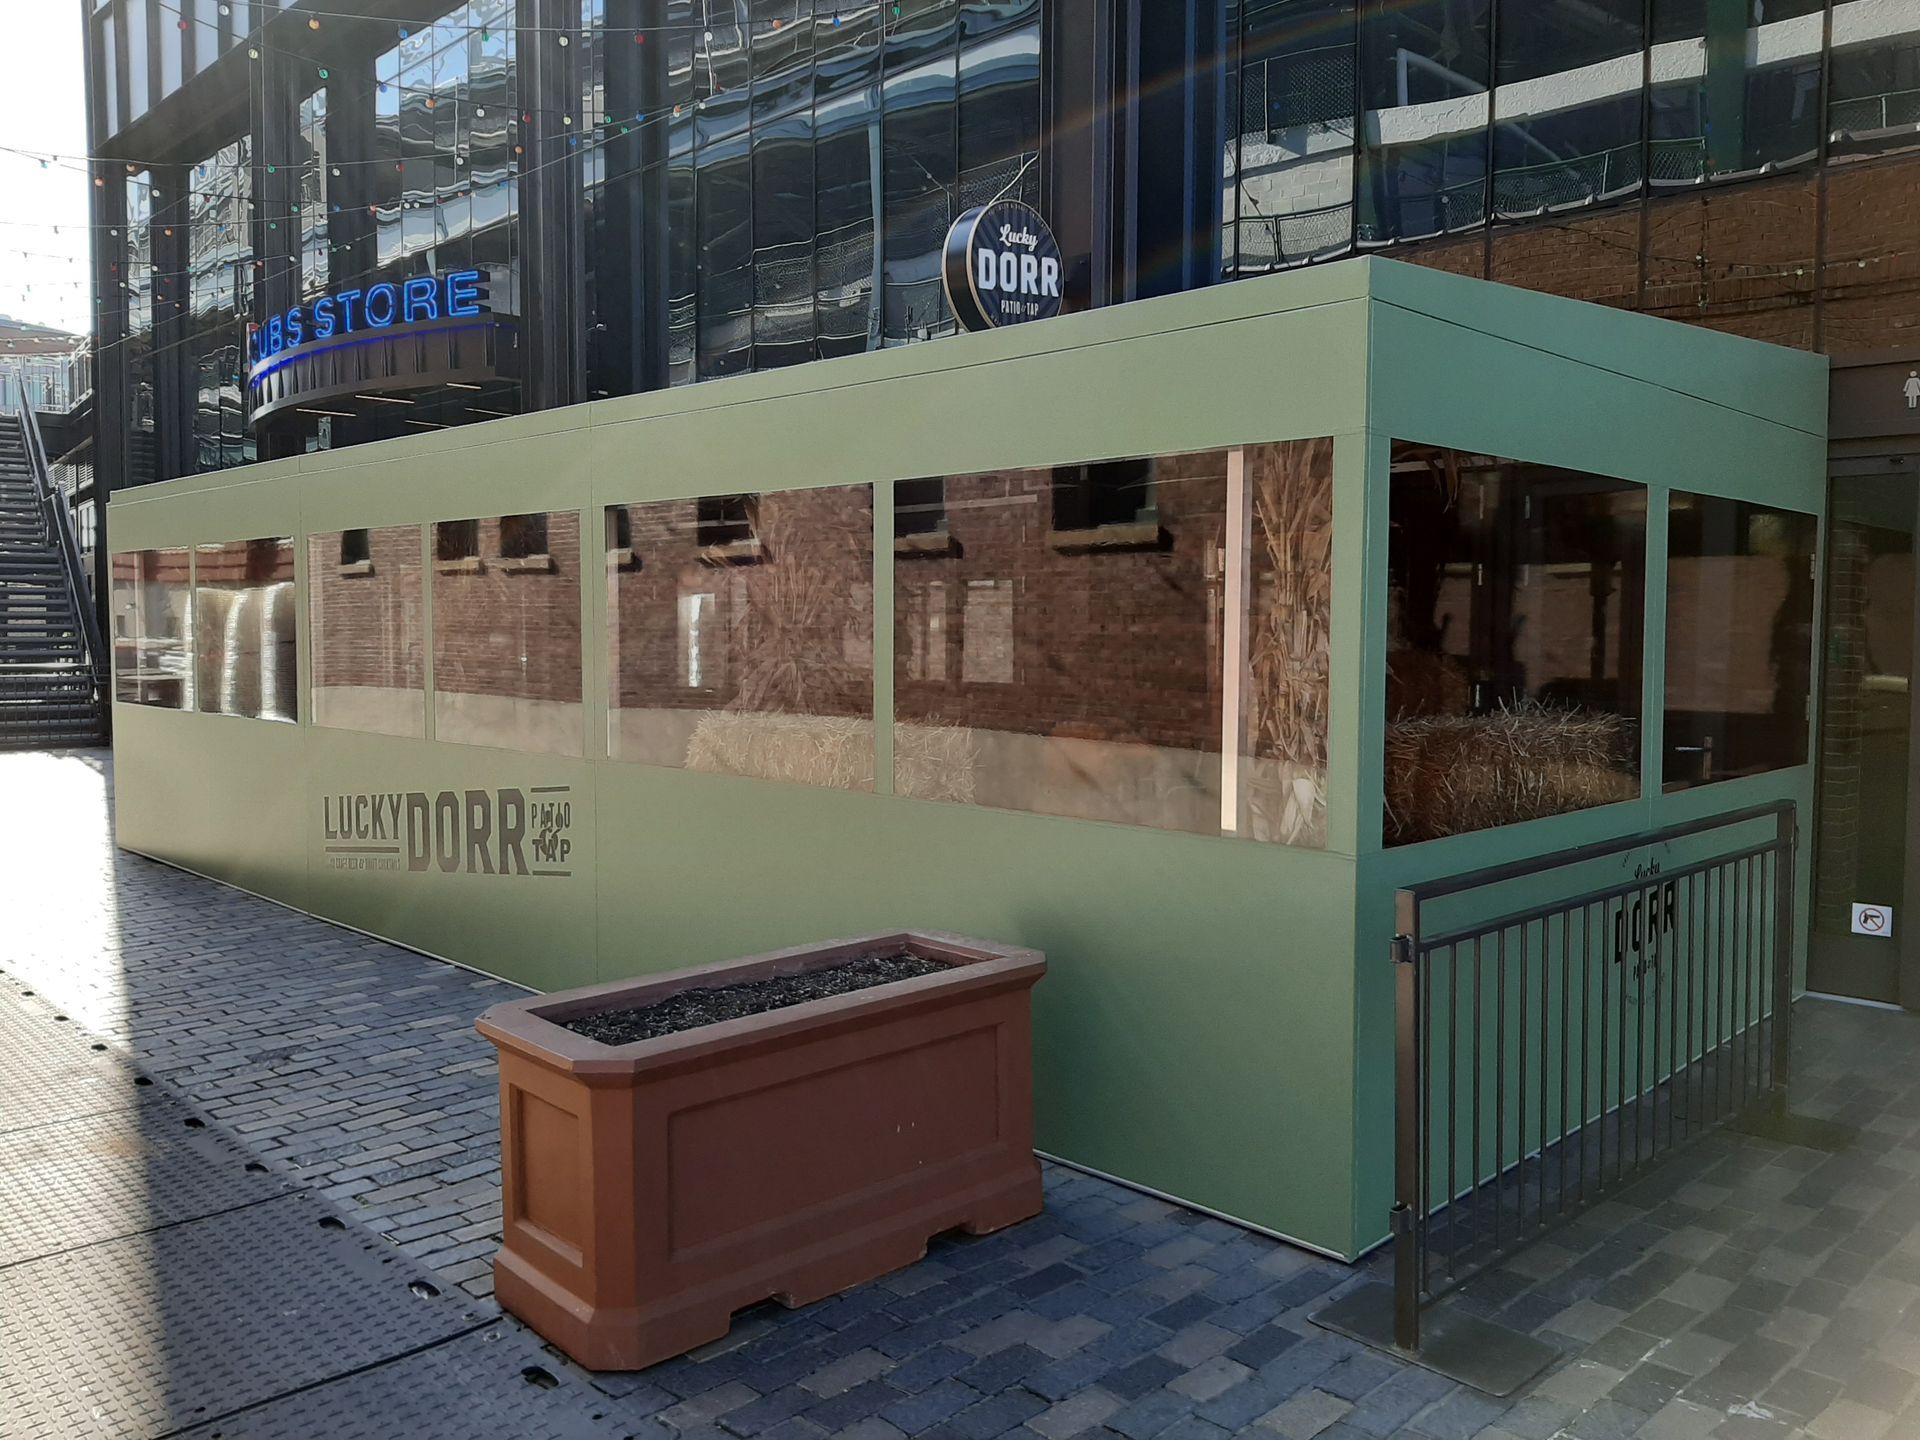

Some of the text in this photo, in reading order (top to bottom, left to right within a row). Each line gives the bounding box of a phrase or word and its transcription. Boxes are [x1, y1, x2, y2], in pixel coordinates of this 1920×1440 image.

[999, 223, 1038, 252] Lucky
[978, 247, 1060, 297] DORR
[314, 270, 481, 340] STORE
[1000, 299, 1022, 315] PATIO
[1026, 302, 1039, 317] TAP
[531, 802, 571, 829] PATIO
[323, 787, 531, 876] LUCKY DORR
[531, 838, 571, 863] TAP
